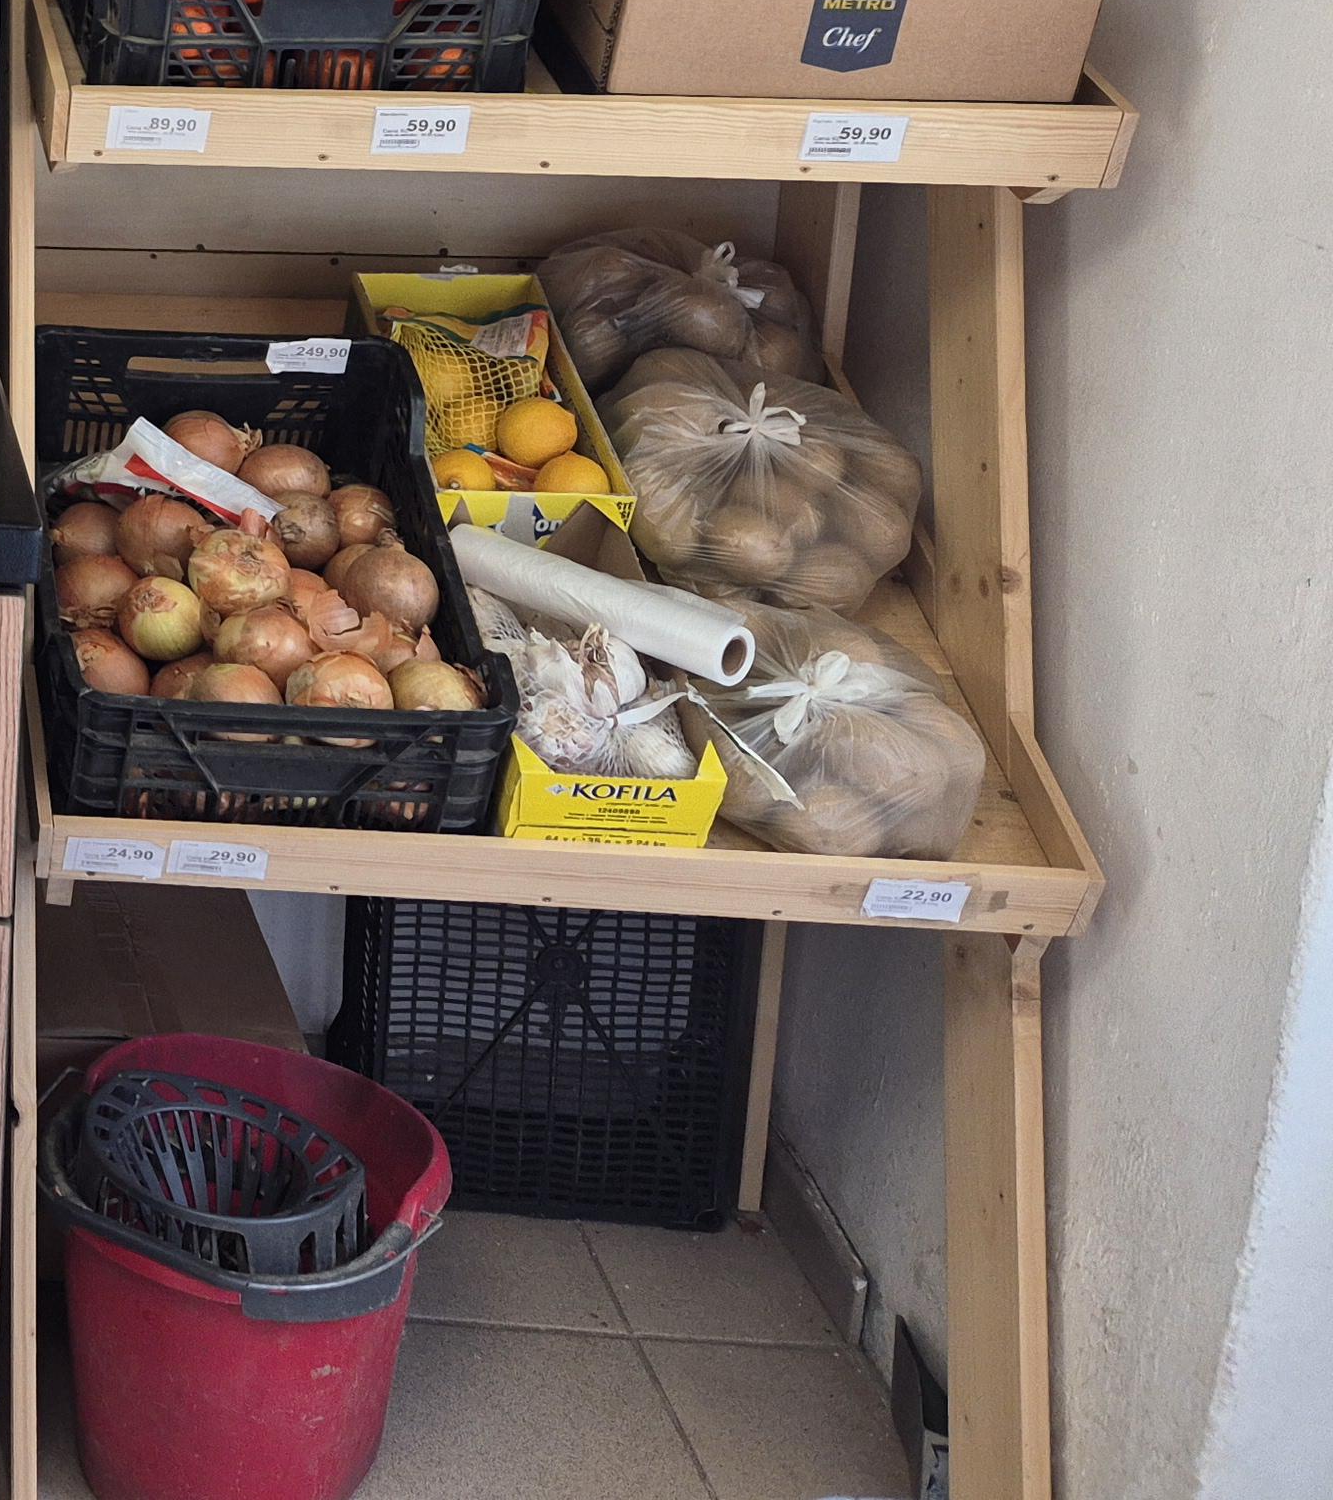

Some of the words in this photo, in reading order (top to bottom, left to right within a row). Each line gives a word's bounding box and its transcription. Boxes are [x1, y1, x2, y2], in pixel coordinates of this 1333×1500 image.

[822, 26, 882, 54] Chef
[150, 118, 196, 133] 89,90
[407, 119, 456, 134] 59,90
[839, 127, 891, 144] 59,90
[296, 346, 348, 358] 249,90
[572, 783, 677, 802] KOFILA
[107, 848, 153, 860] 24,90
[209, 850, 256, 863] 29,90
[901, 890, 952, 903] 22,90
